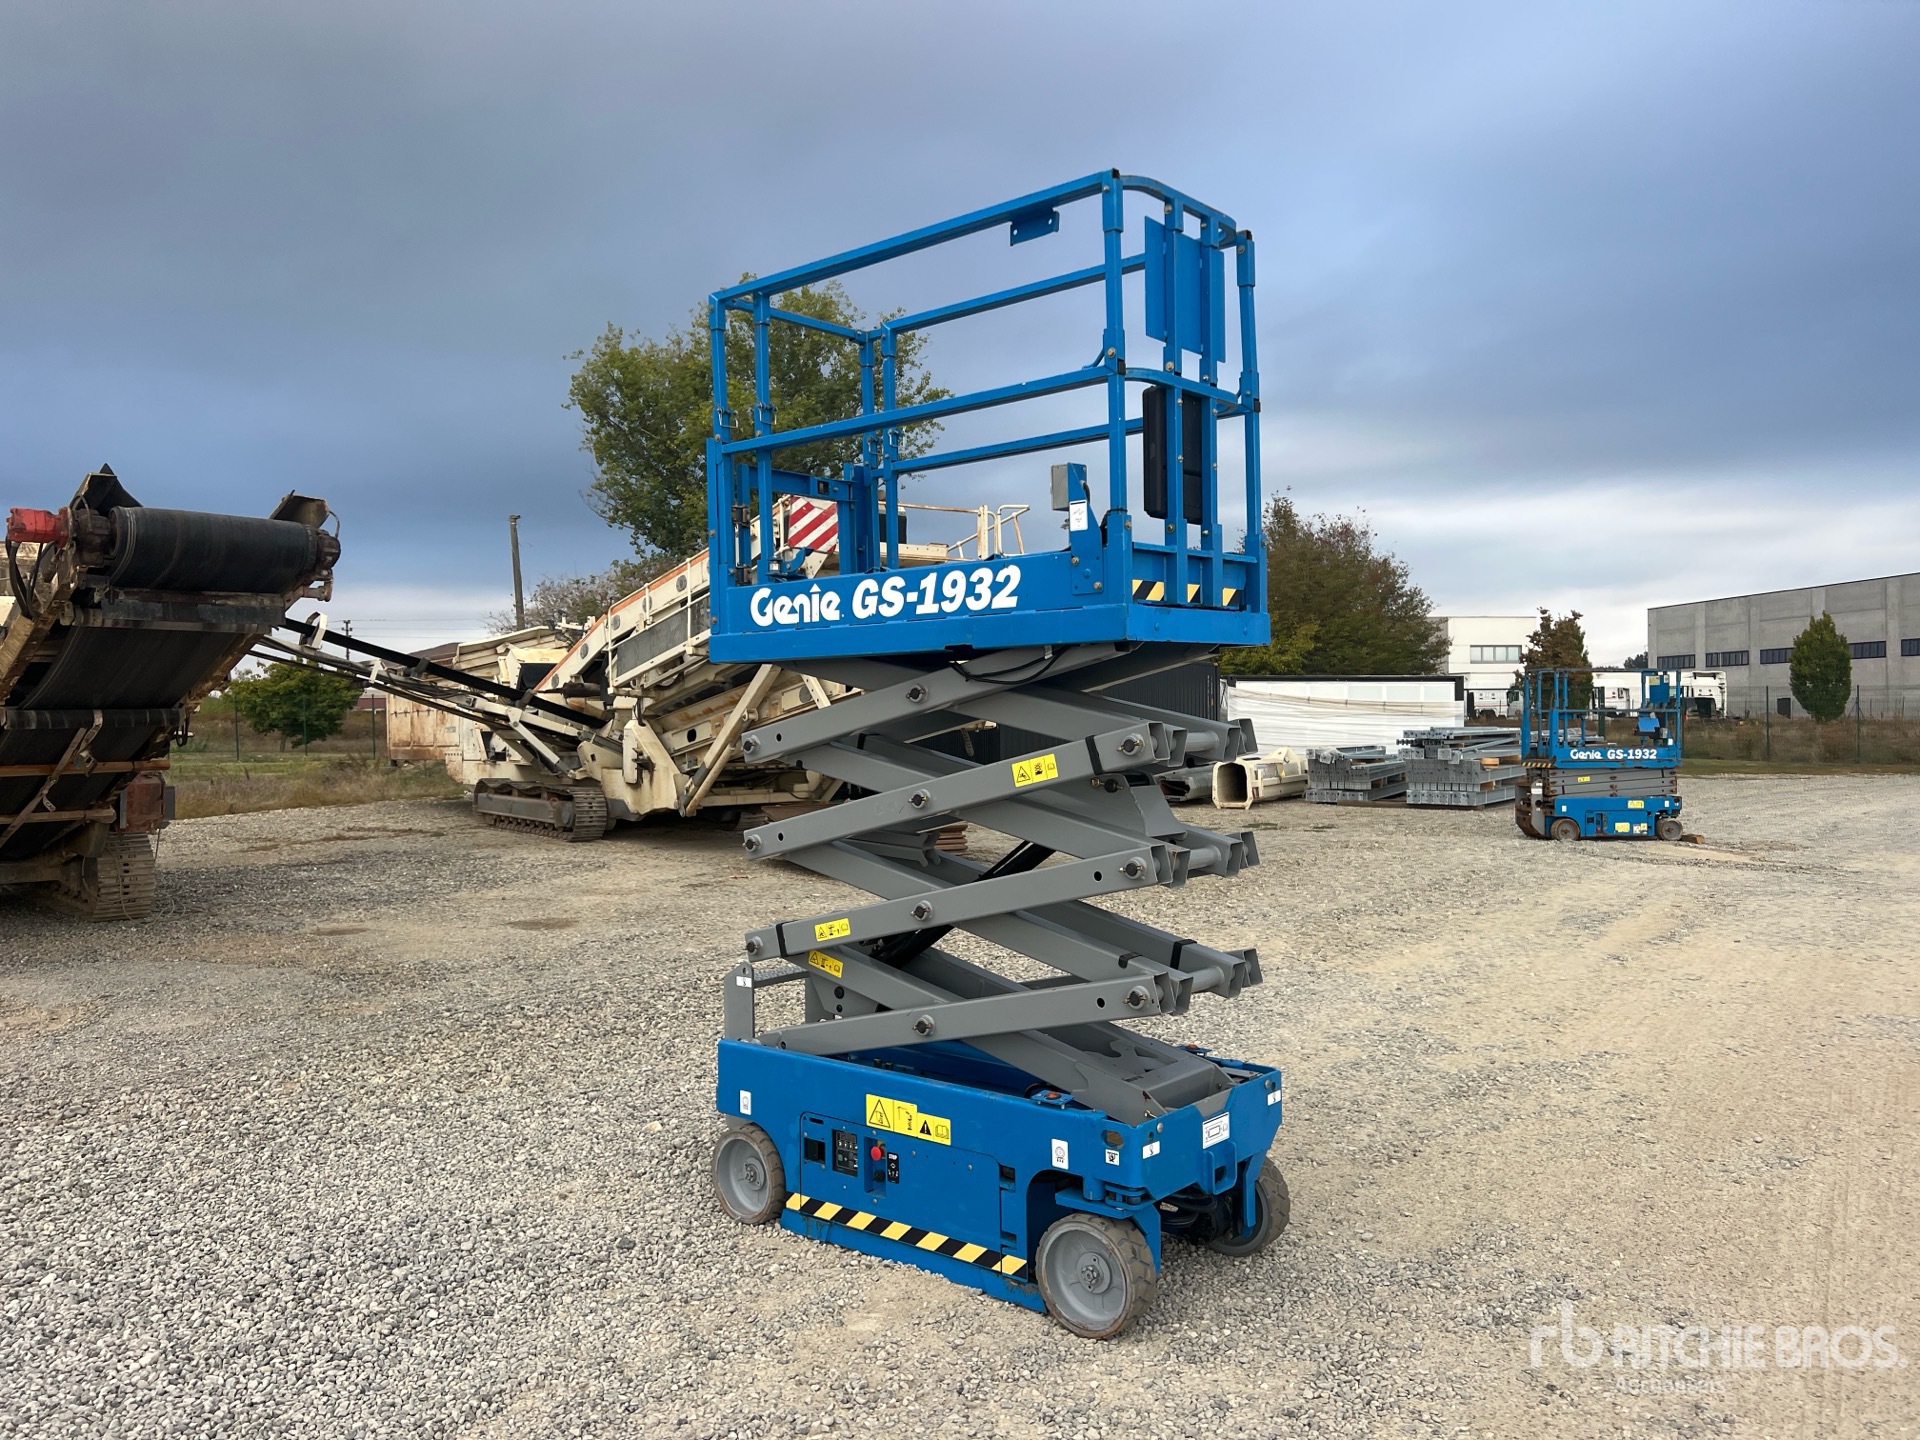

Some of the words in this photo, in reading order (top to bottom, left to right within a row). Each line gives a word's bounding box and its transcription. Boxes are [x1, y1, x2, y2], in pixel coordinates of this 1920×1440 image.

[750, 583, 840, 627] Genie
[852, 565, 1021, 619] GS-1932
[1570, 749, 1602, 760] Genie
[1607, 748, 1657, 760] GS-1932
